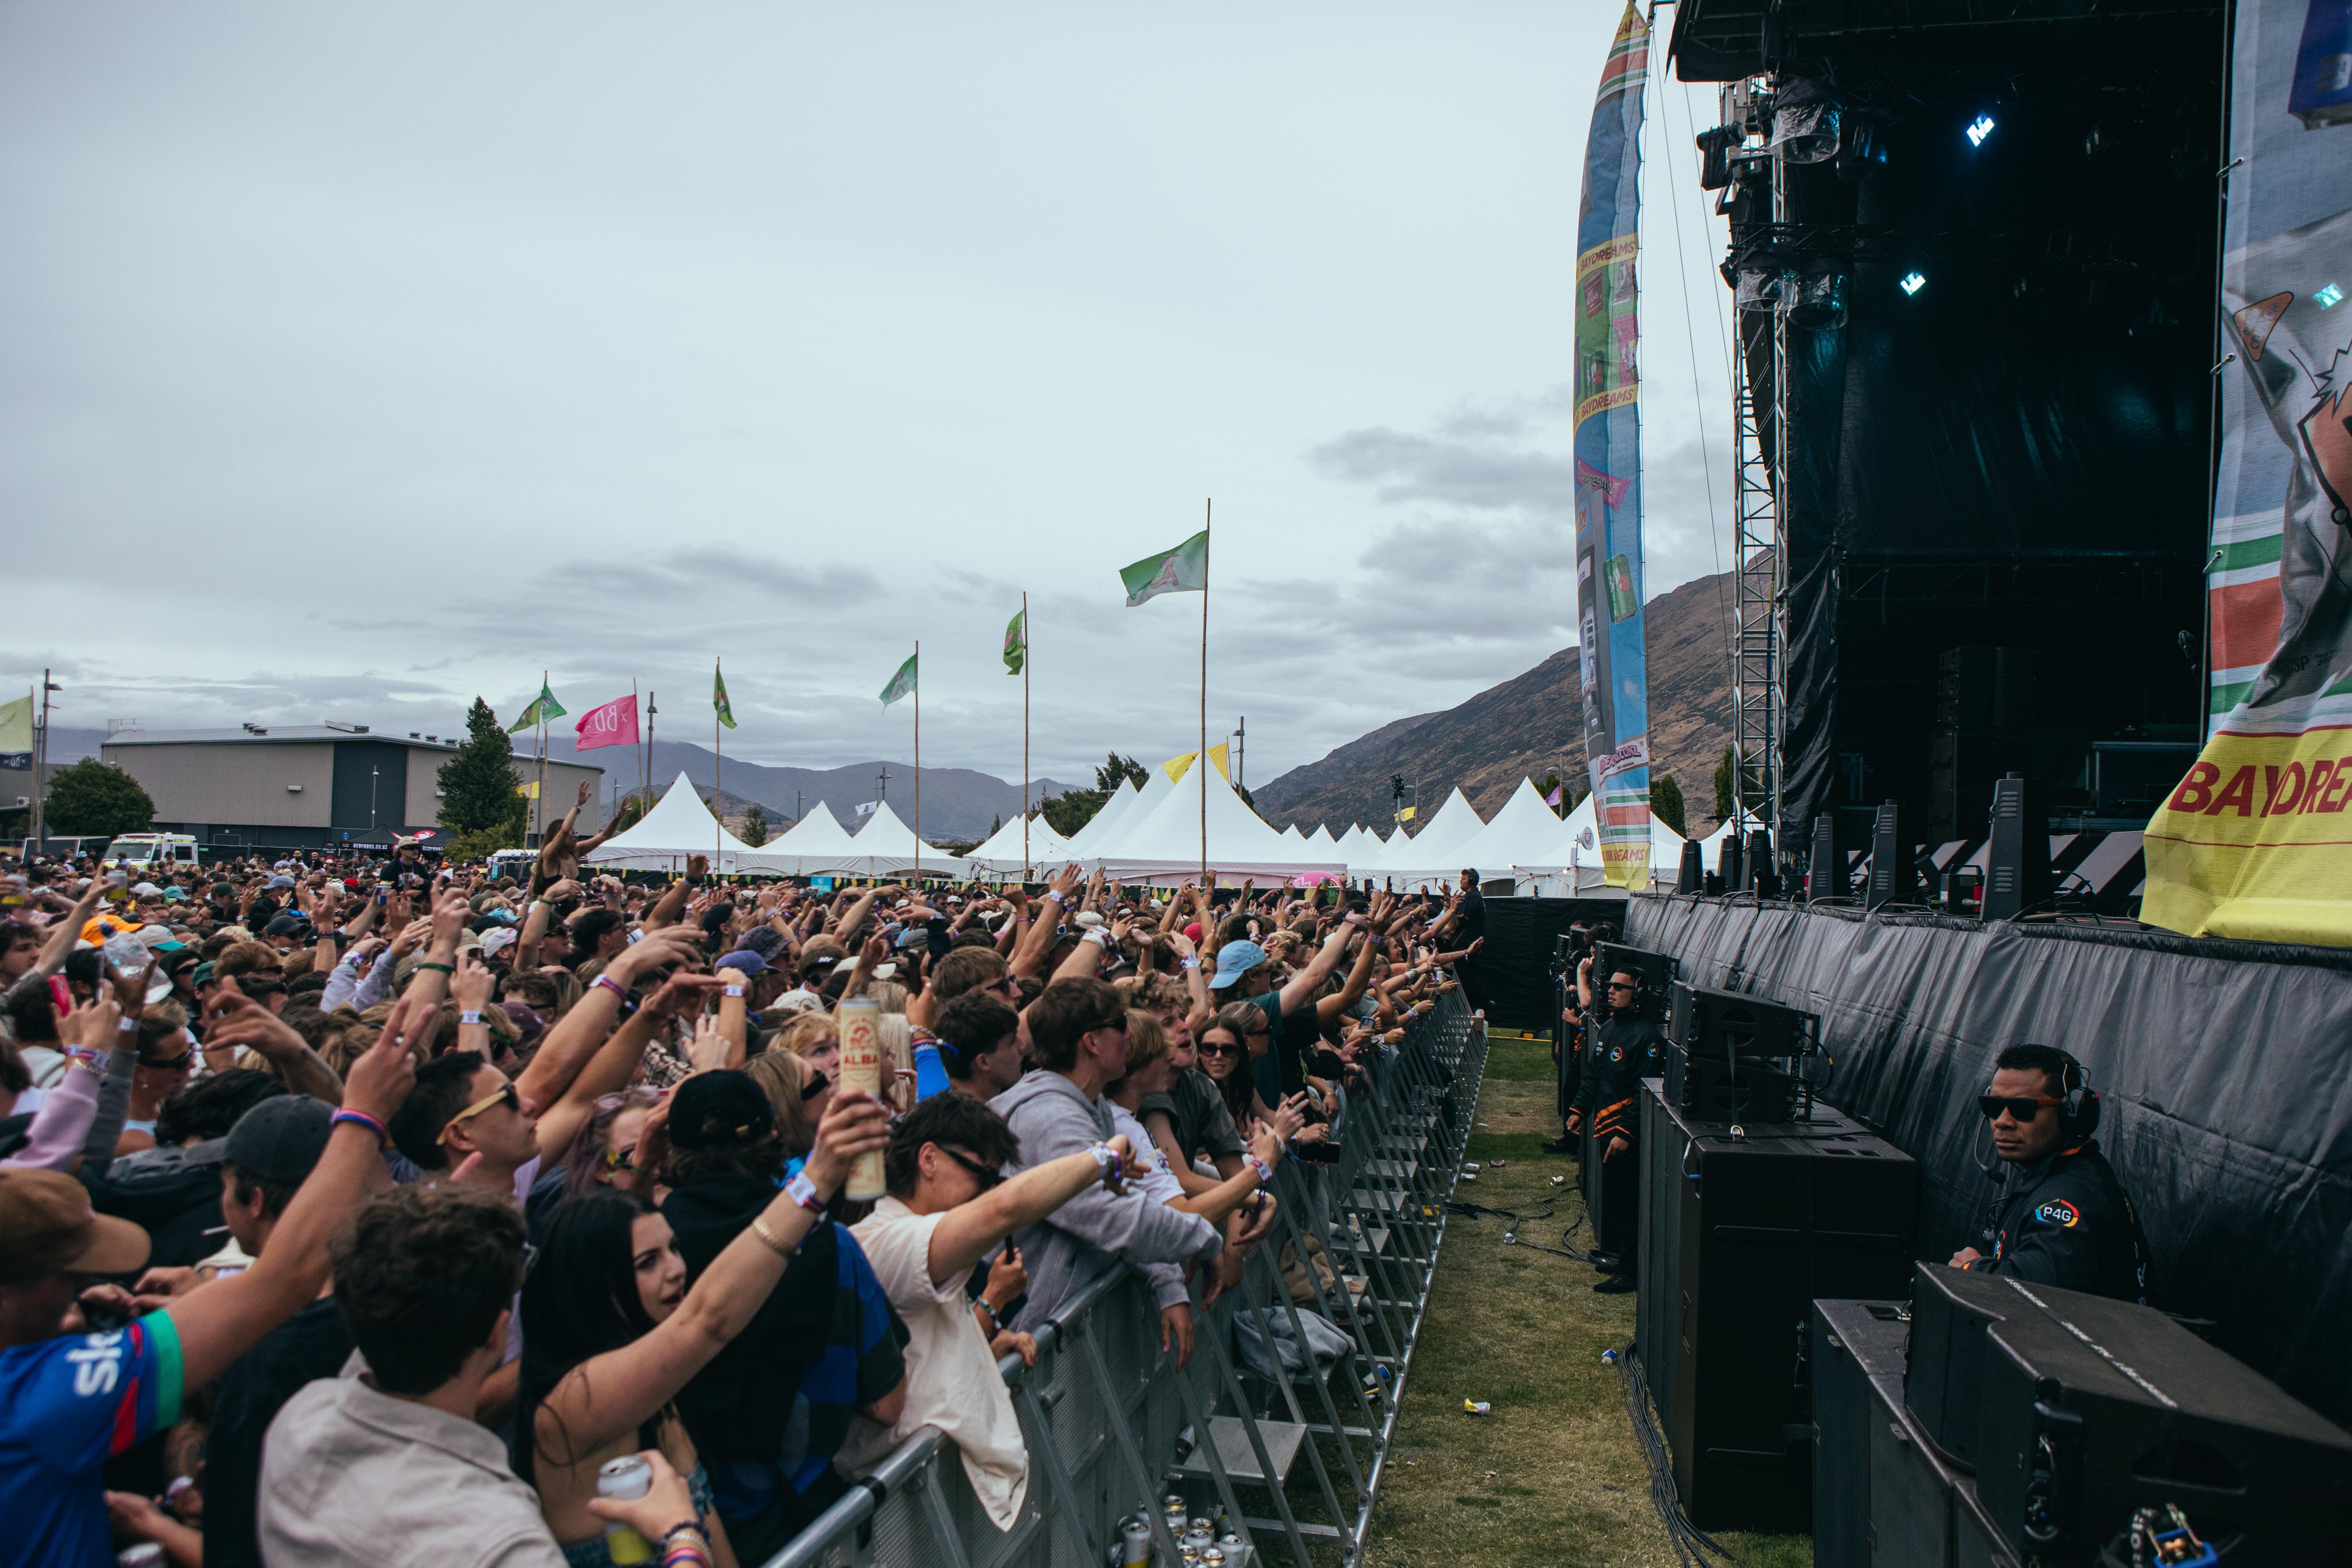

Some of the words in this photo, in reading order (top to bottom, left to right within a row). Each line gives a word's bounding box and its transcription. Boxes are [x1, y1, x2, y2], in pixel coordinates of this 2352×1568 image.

[1581, 240, 1635, 273] BAYDREAMS
[1581, 388, 1634, 418] BAYDREAMS
[2043, 1206, 2071, 1221] P4G
